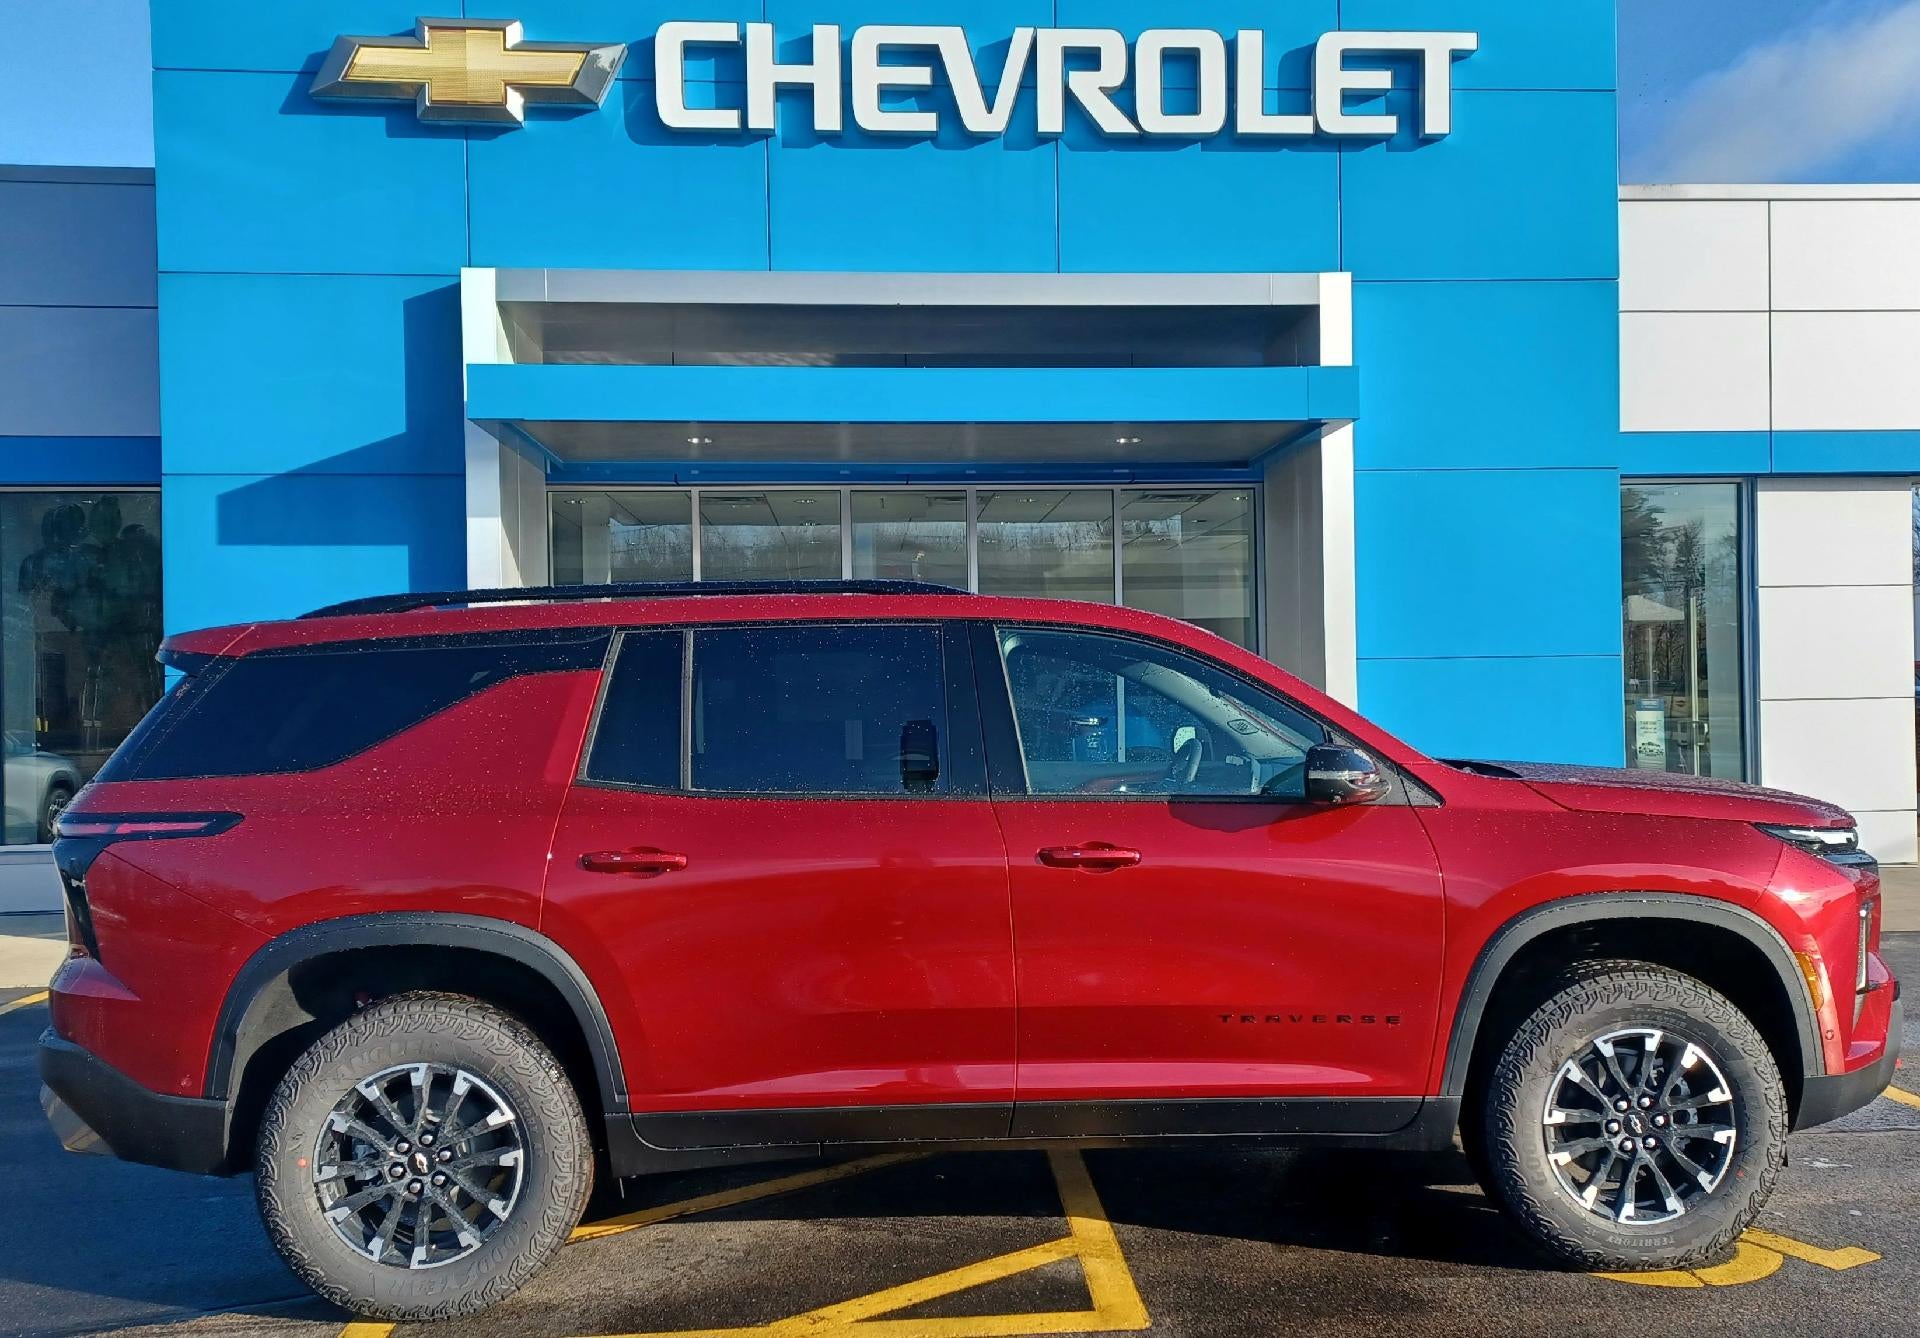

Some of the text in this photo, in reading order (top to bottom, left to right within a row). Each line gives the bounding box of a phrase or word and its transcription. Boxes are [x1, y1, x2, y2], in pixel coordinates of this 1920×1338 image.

[655, 21, 1478, 138] CHEVROLET
[1218, 1014, 1401, 1024] TRAVERSE
[1606, 1235, 1675, 1247] TERRITORY
